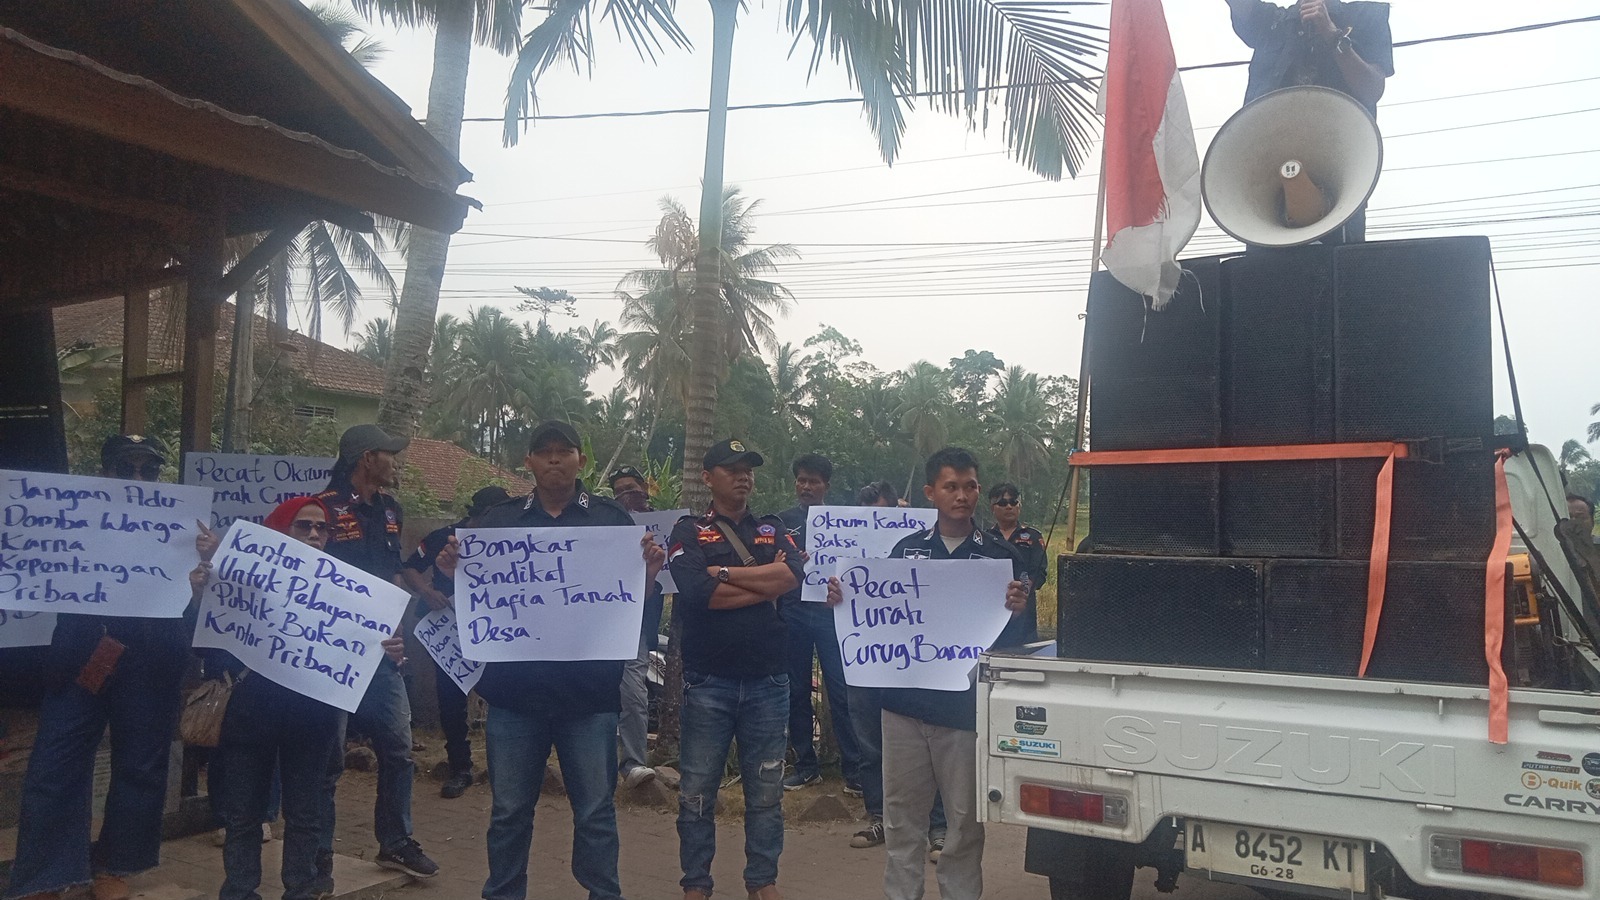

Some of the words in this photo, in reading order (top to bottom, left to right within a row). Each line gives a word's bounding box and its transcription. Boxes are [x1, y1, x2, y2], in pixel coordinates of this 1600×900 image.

[195, 457, 265, 483] Pecat
[8, 478, 111, 511] Jangan
[124, 485, 184, 508] Adu
[4, 504, 89, 530] Domba
[101, 512, 187, 543] Warga
[812, 511, 868, 530] Oknum
[1, 532, 86, 552] Karna
[457, 534, 579, 564] Bongkar
[813, 533, 858, 548] Saksi
[0, 553, 172, 584] Kepentingan
[217, 555, 283, 594] Untuk
[230, 528, 306, 572] Kantor
[313, 557, 372, 598] Desa
[463, 556, 565, 589] Sindikat
[841, 565, 930, 598] Pecat
[470, 587, 544, 620] Mafia
[553, 579, 636, 606] Tanah
[851, 599, 925, 628] Lurah
[204, 610, 263, 648] Kantor
[267, 634, 360, 690] Pribadi
[1019, 740, 1056, 750] SUZUKI
[1103, 715, 1456, 797] SUZUKI
[1504, 793, 1600, 815] CARRY
[1191, 824, 1206, 853] A
[1235, 829, 1303, 866] 8452
[1323, 839, 1358, 873] KT
